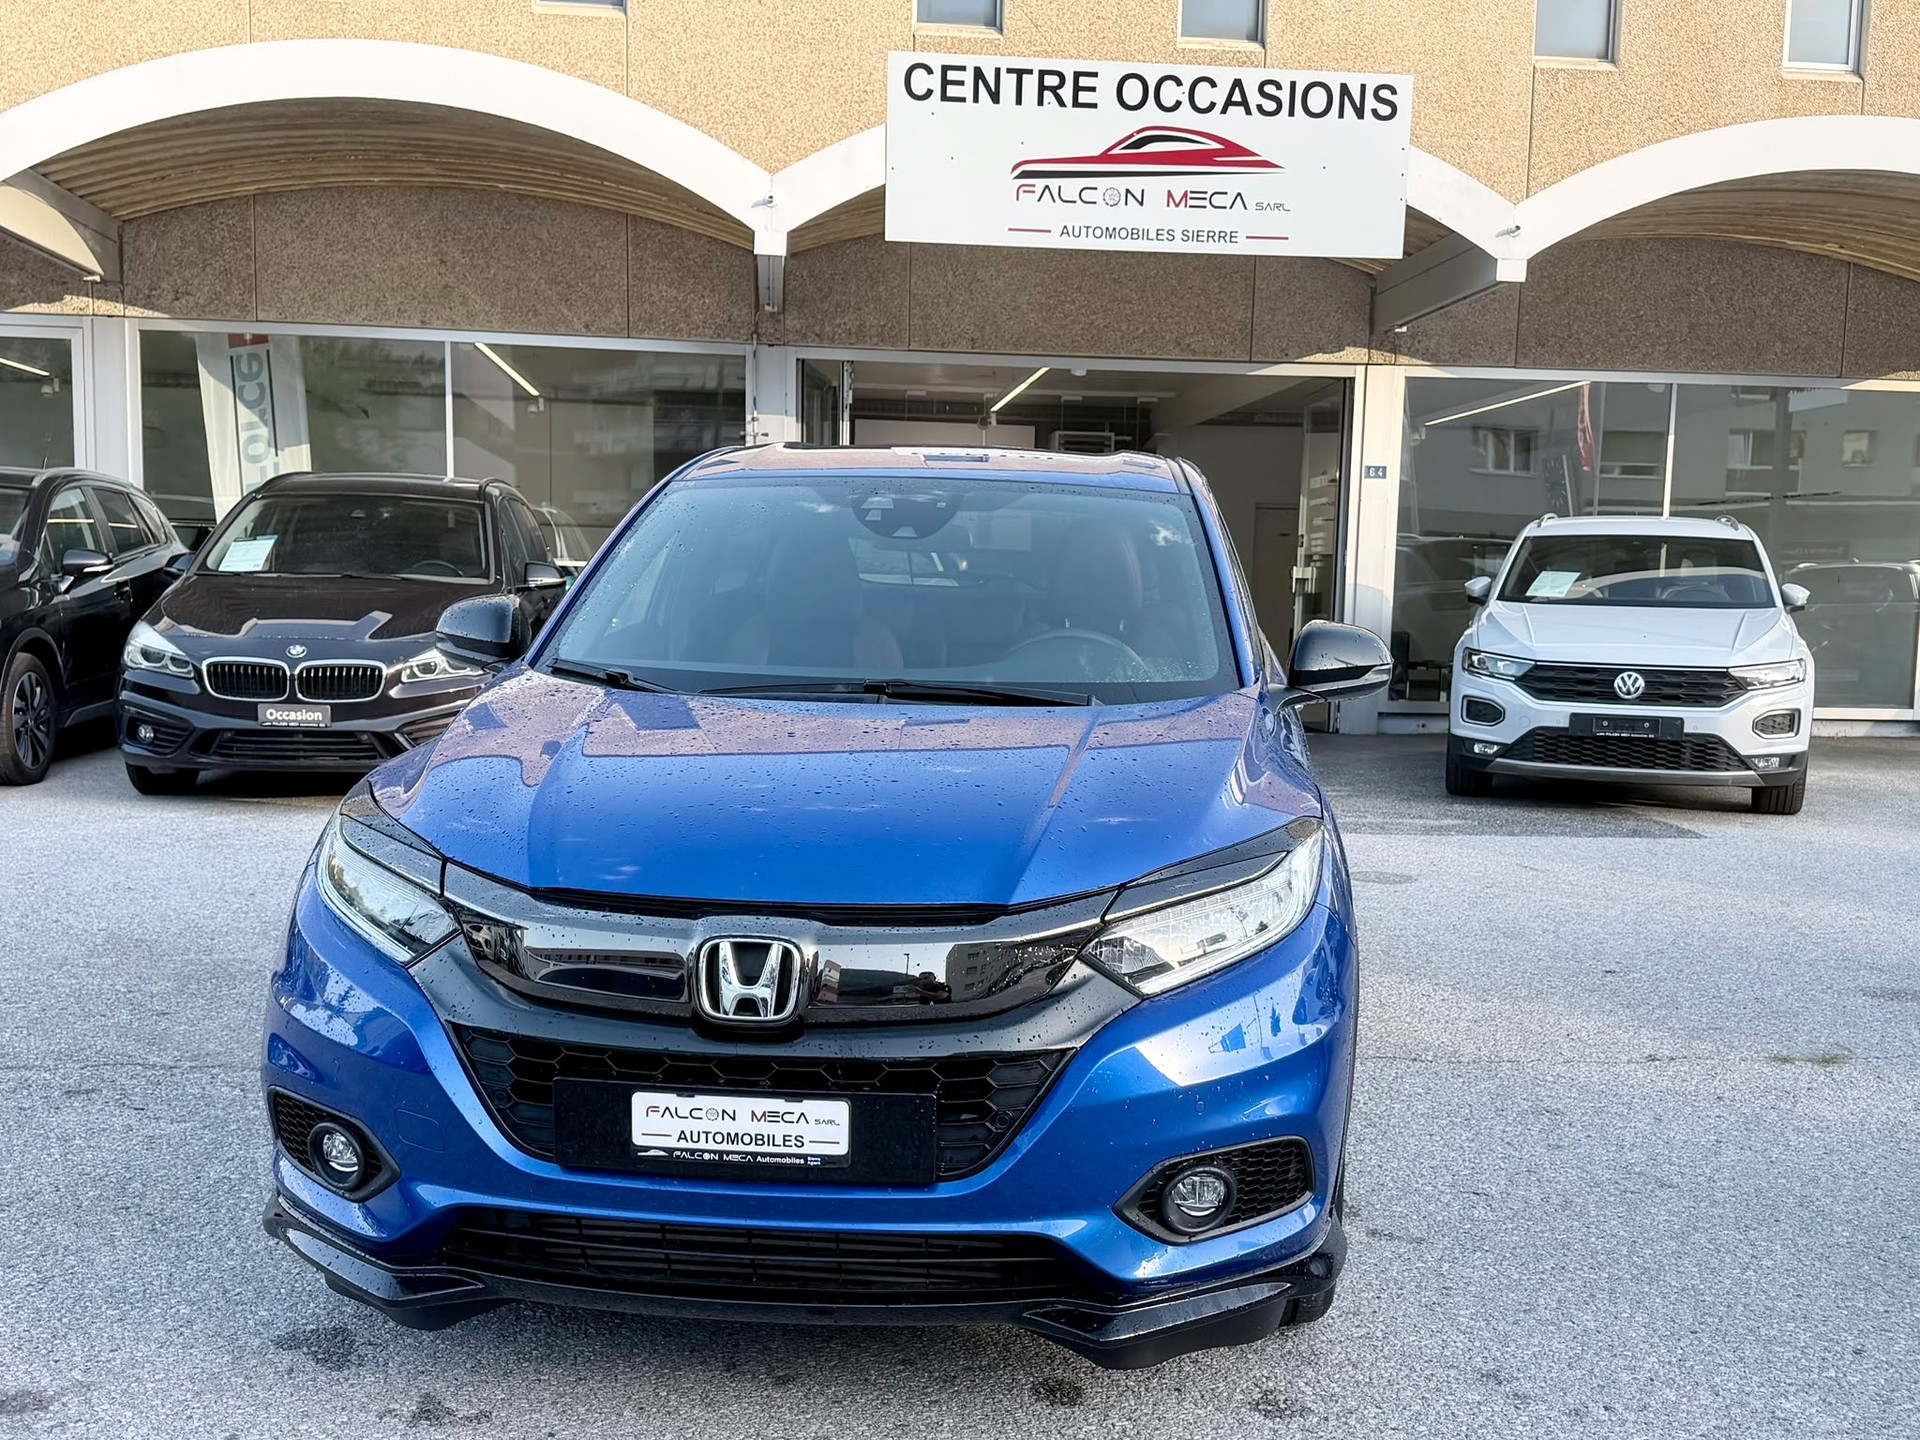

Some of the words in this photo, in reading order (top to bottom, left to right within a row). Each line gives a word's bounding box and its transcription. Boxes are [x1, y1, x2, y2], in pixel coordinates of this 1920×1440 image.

[903, 62, 1100, 110] CENTRE
[1115, 72, 1399, 122] OCCASIONS
[1016, 183, 1145, 207] FALCON
[1166, 189, 1248, 210] MECA
[1255, 202, 1291, 212] SARL
[1059, 224, 1176, 242] AUTOMOBILES
[1180, 229, 1239, 244] SIERRE
[1369, 467, 1383, 477] 64
[266, 708, 323, 721] Occasion
[645, 1105, 737, 1122] FALCON
[751, 1109, 810, 1125] MECA
[814, 1118, 840, 1126] SARL
[676, 1129, 805, 1148] AUTOMOBILES
[673, 1150, 719, 1161] FALCON
[723, 1153, 754, 1163] MECA
[756, 1155, 805, 1165] Automobiles
